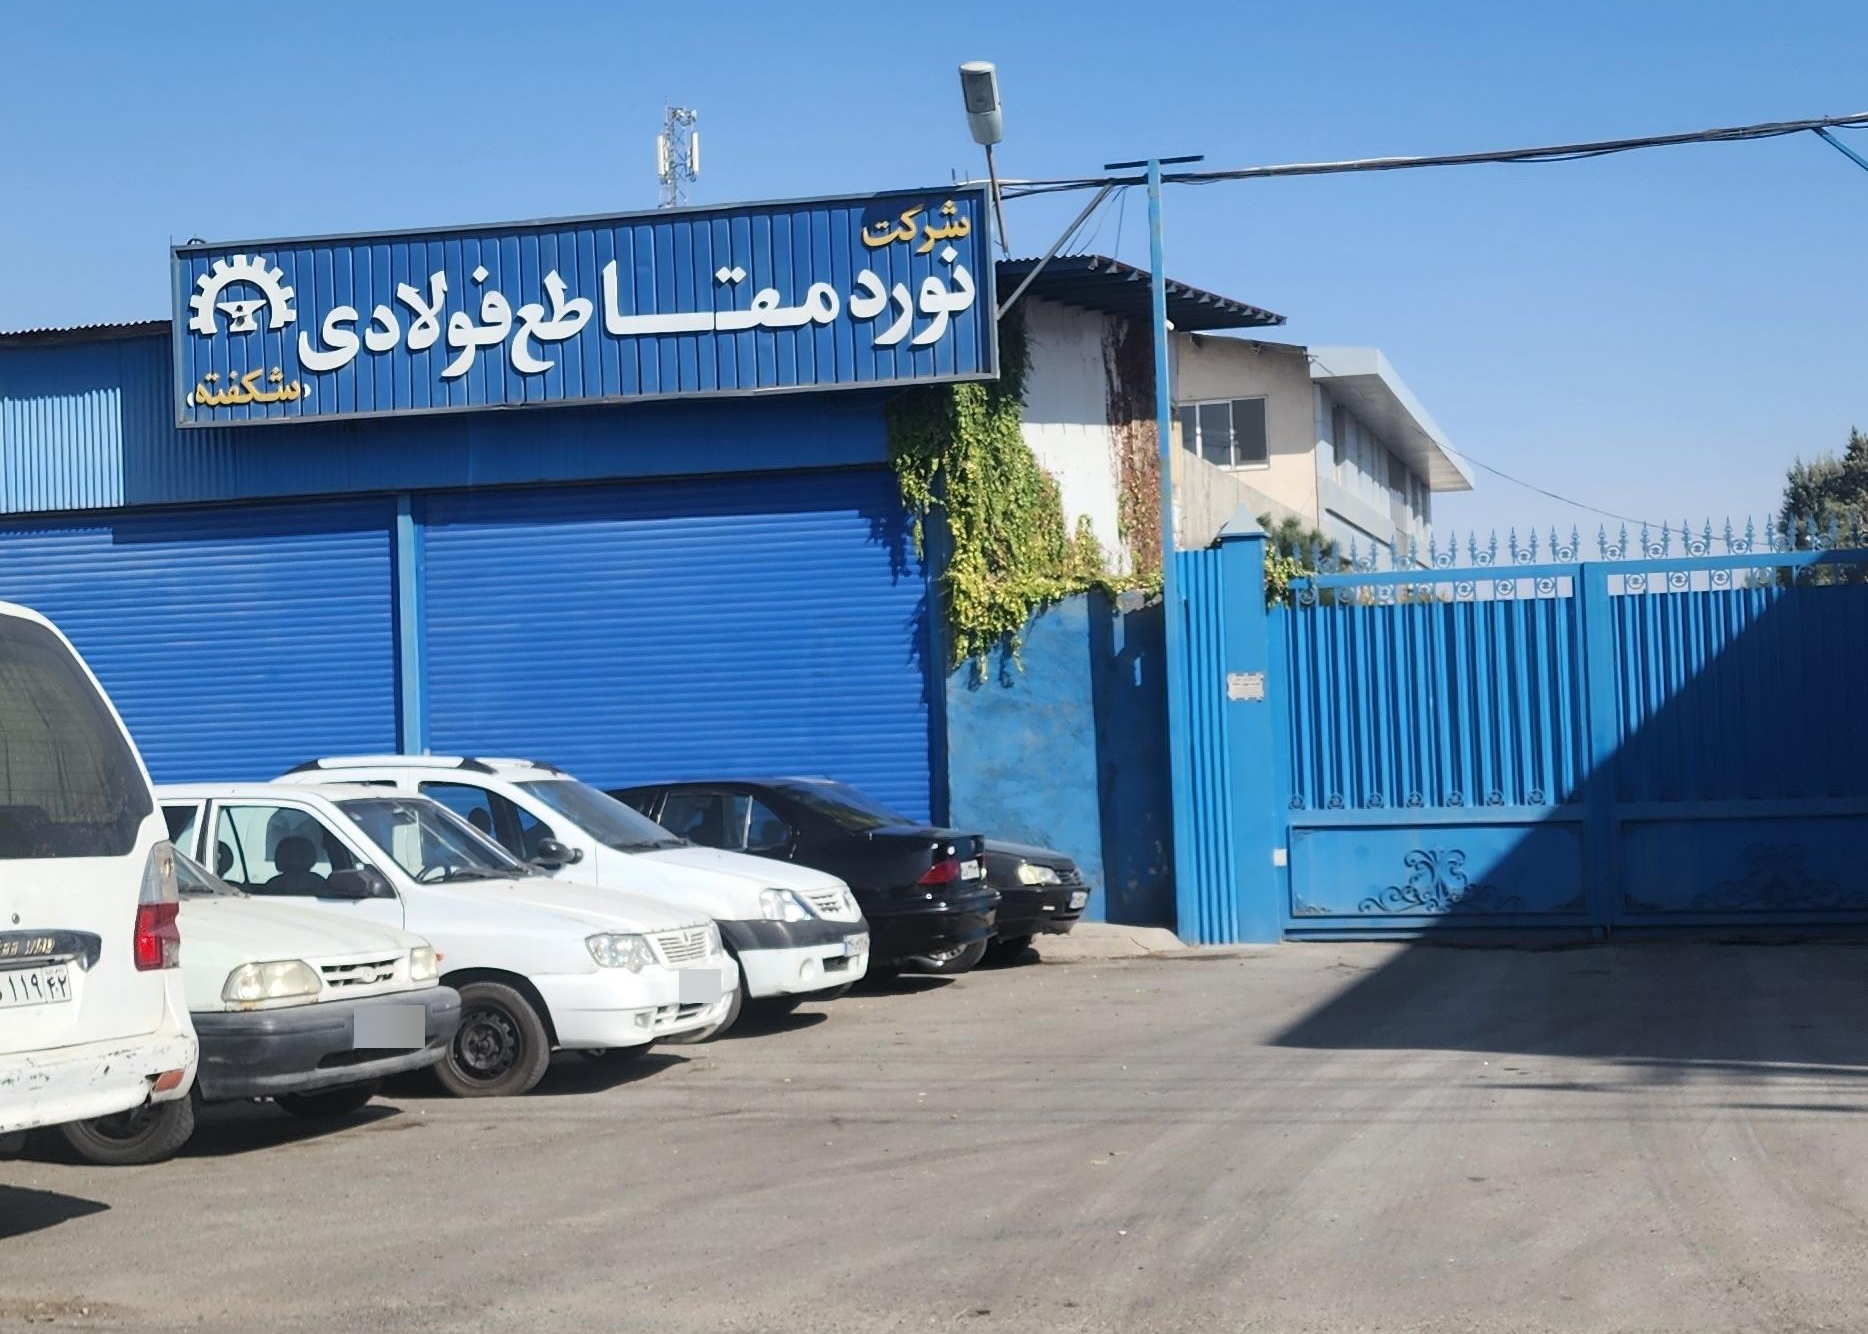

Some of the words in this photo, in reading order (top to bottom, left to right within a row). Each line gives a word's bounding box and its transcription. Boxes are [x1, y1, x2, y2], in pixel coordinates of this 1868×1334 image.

[863, 200, 970, 253] شرکت
[298, 265, 512, 378] فولادی
[511, 259, 839, 373] مقاطع
[850, 246, 976, 345] نورد
